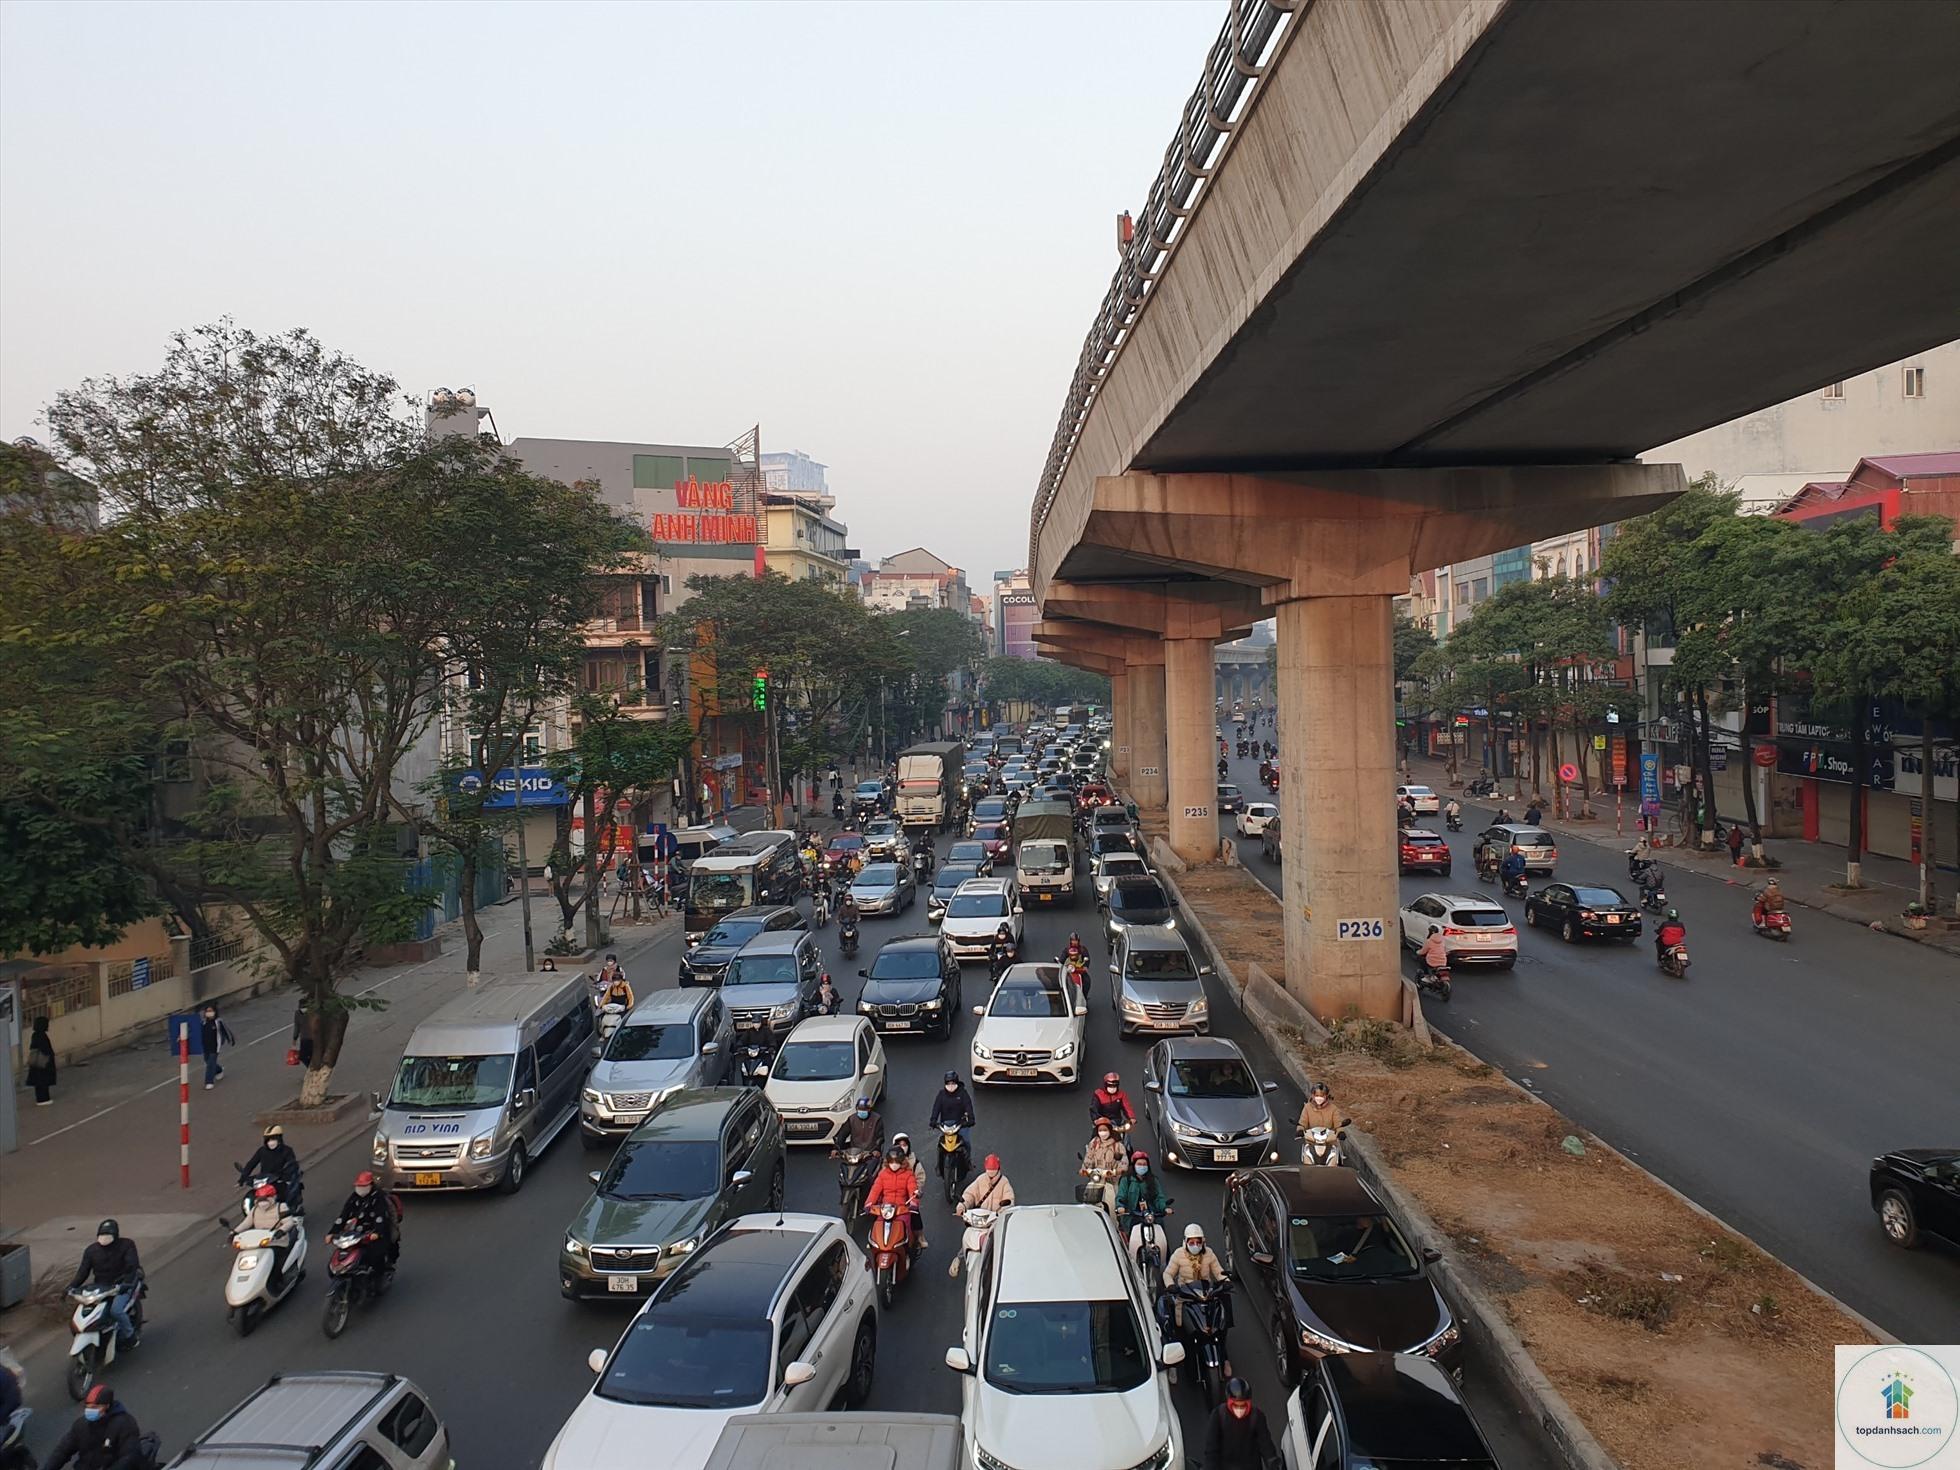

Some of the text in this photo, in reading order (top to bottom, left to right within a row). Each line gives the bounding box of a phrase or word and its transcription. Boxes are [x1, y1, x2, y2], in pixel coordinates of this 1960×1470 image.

[652, 513, 756, 543] ANH MINH
[1185, 808, 1208, 817] P235
[1339, 920, 1382, 938] P236
